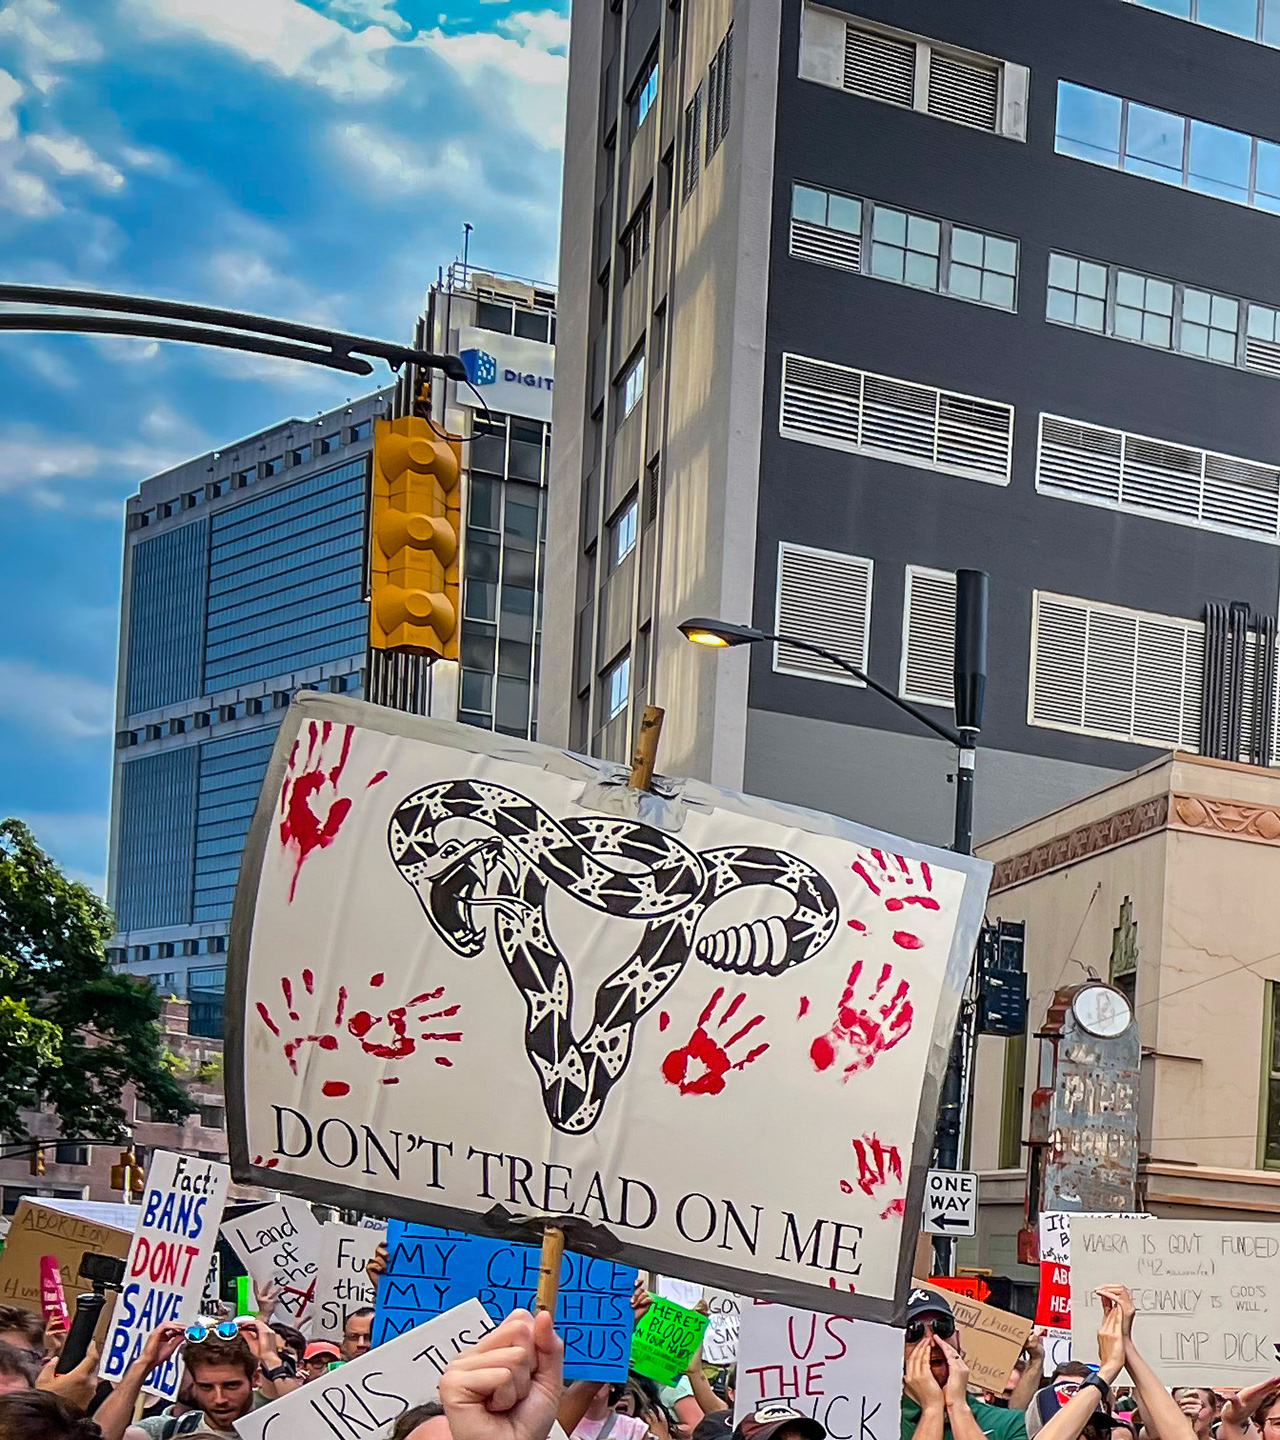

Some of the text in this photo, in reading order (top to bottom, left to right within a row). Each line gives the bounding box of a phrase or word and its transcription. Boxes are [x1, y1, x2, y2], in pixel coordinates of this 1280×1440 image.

[172, 1157, 218, 1195] Fact:
[271, 1103, 865, 1277] DON'T TREAD ON ME
[930, 1176, 973, 1192] ONE
[142, 1189, 208, 1240] BANS
[930, 1195, 971, 1212] WAY
[21, 1208, 110, 1245] ABORTION
[235, 1205, 299, 1255] Land
[272, 1240, 300, 1268] of
[389, 1242, 457, 1278] MY
[1082, 1233, 1130, 1254] VIAGRA
[1141, 1234, 1156, 1254] IS
[1221, 1235, 1280, 1258] FUNDED
[130, 1236, 200, 1288] DONT
[273, 1261, 319, 1289] the
[333, 1278, 376, 1304] this
[383, 1280, 451, 1310] MY
[1211, 1295, 1223, 1308] IS
[1229, 1284, 1267, 1298] GOD'S
[650, 1317, 696, 1348] BLOOD
[788, 1313, 855, 1360] US
[954, 1304, 1025, 1340] my choice
[1159, 1331, 1210, 1361] LIMP
[1223, 1332, 1270, 1362] DICK
[745, 1361, 827, 1399] THE
